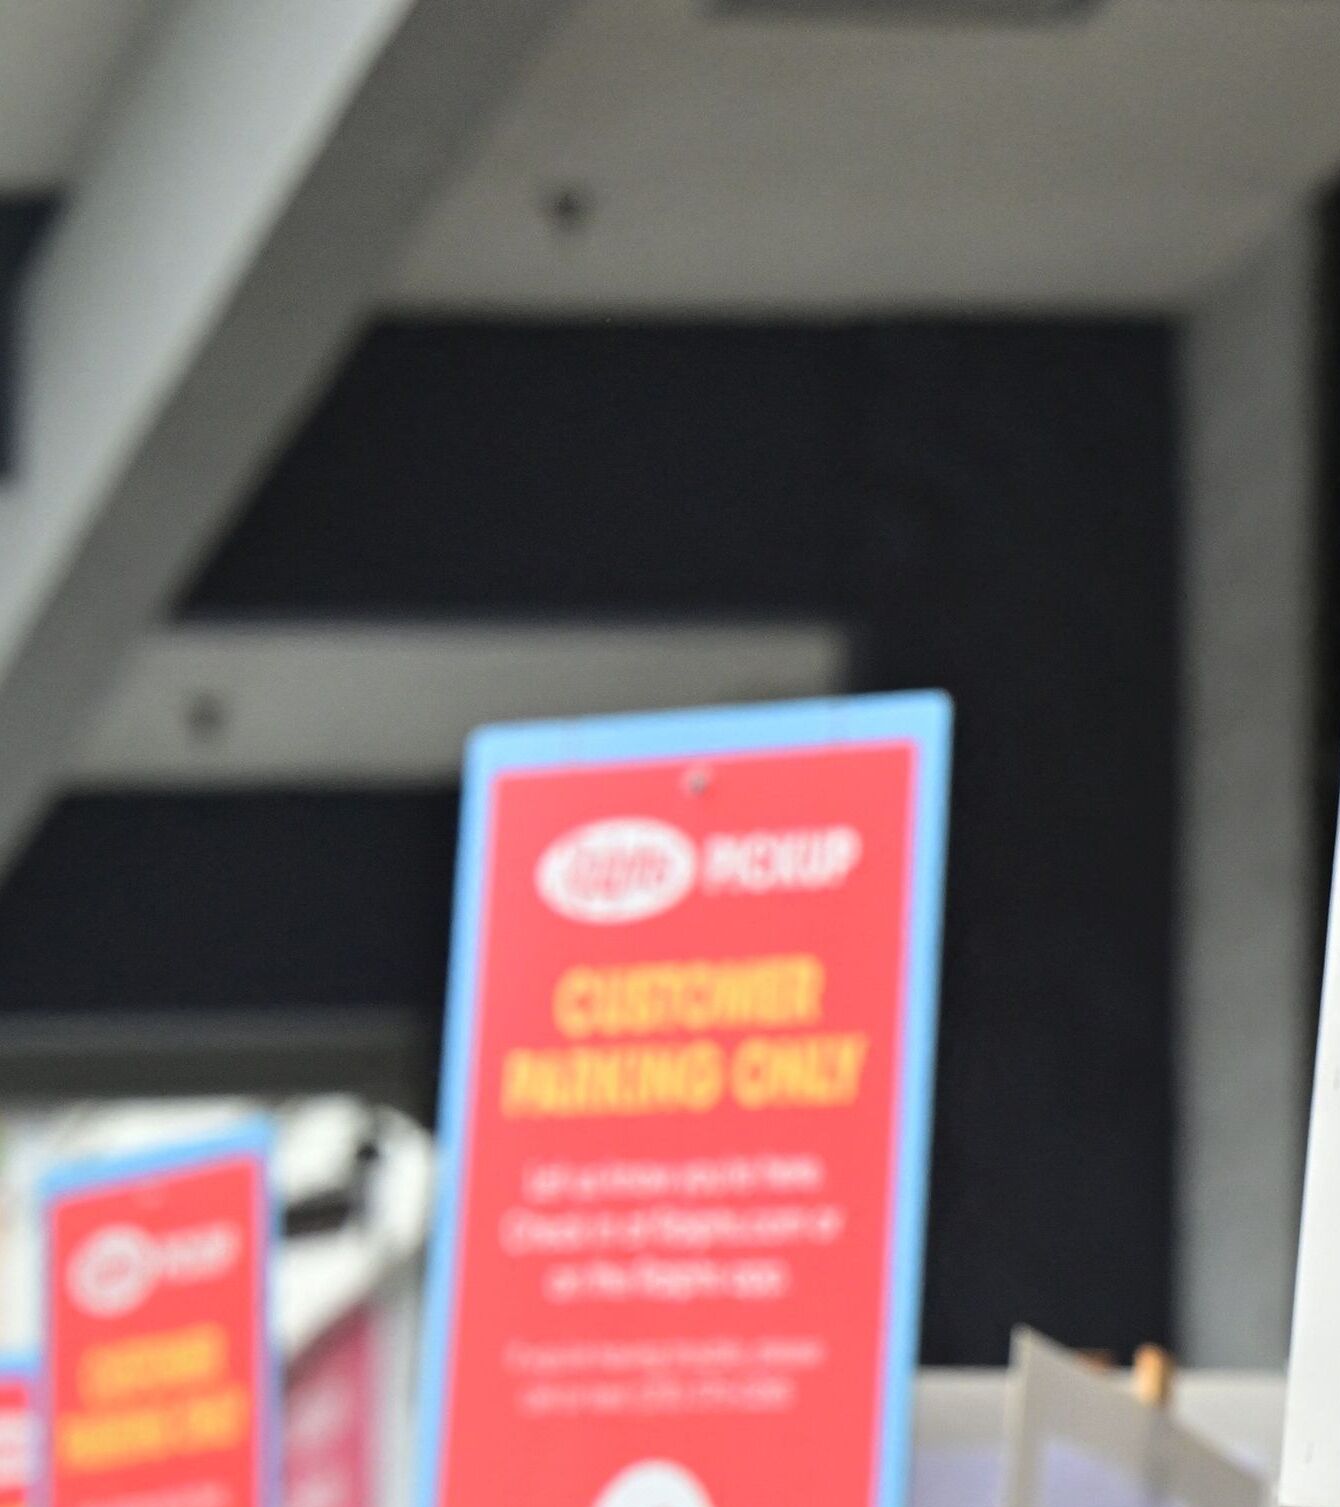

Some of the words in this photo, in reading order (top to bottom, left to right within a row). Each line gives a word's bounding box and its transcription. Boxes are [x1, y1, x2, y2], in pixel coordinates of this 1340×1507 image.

[554, 954, 823, 1037] CUSTOMER
[503, 1041, 724, 1117] PARKING
[732, 1032, 867, 1108] ONLY
